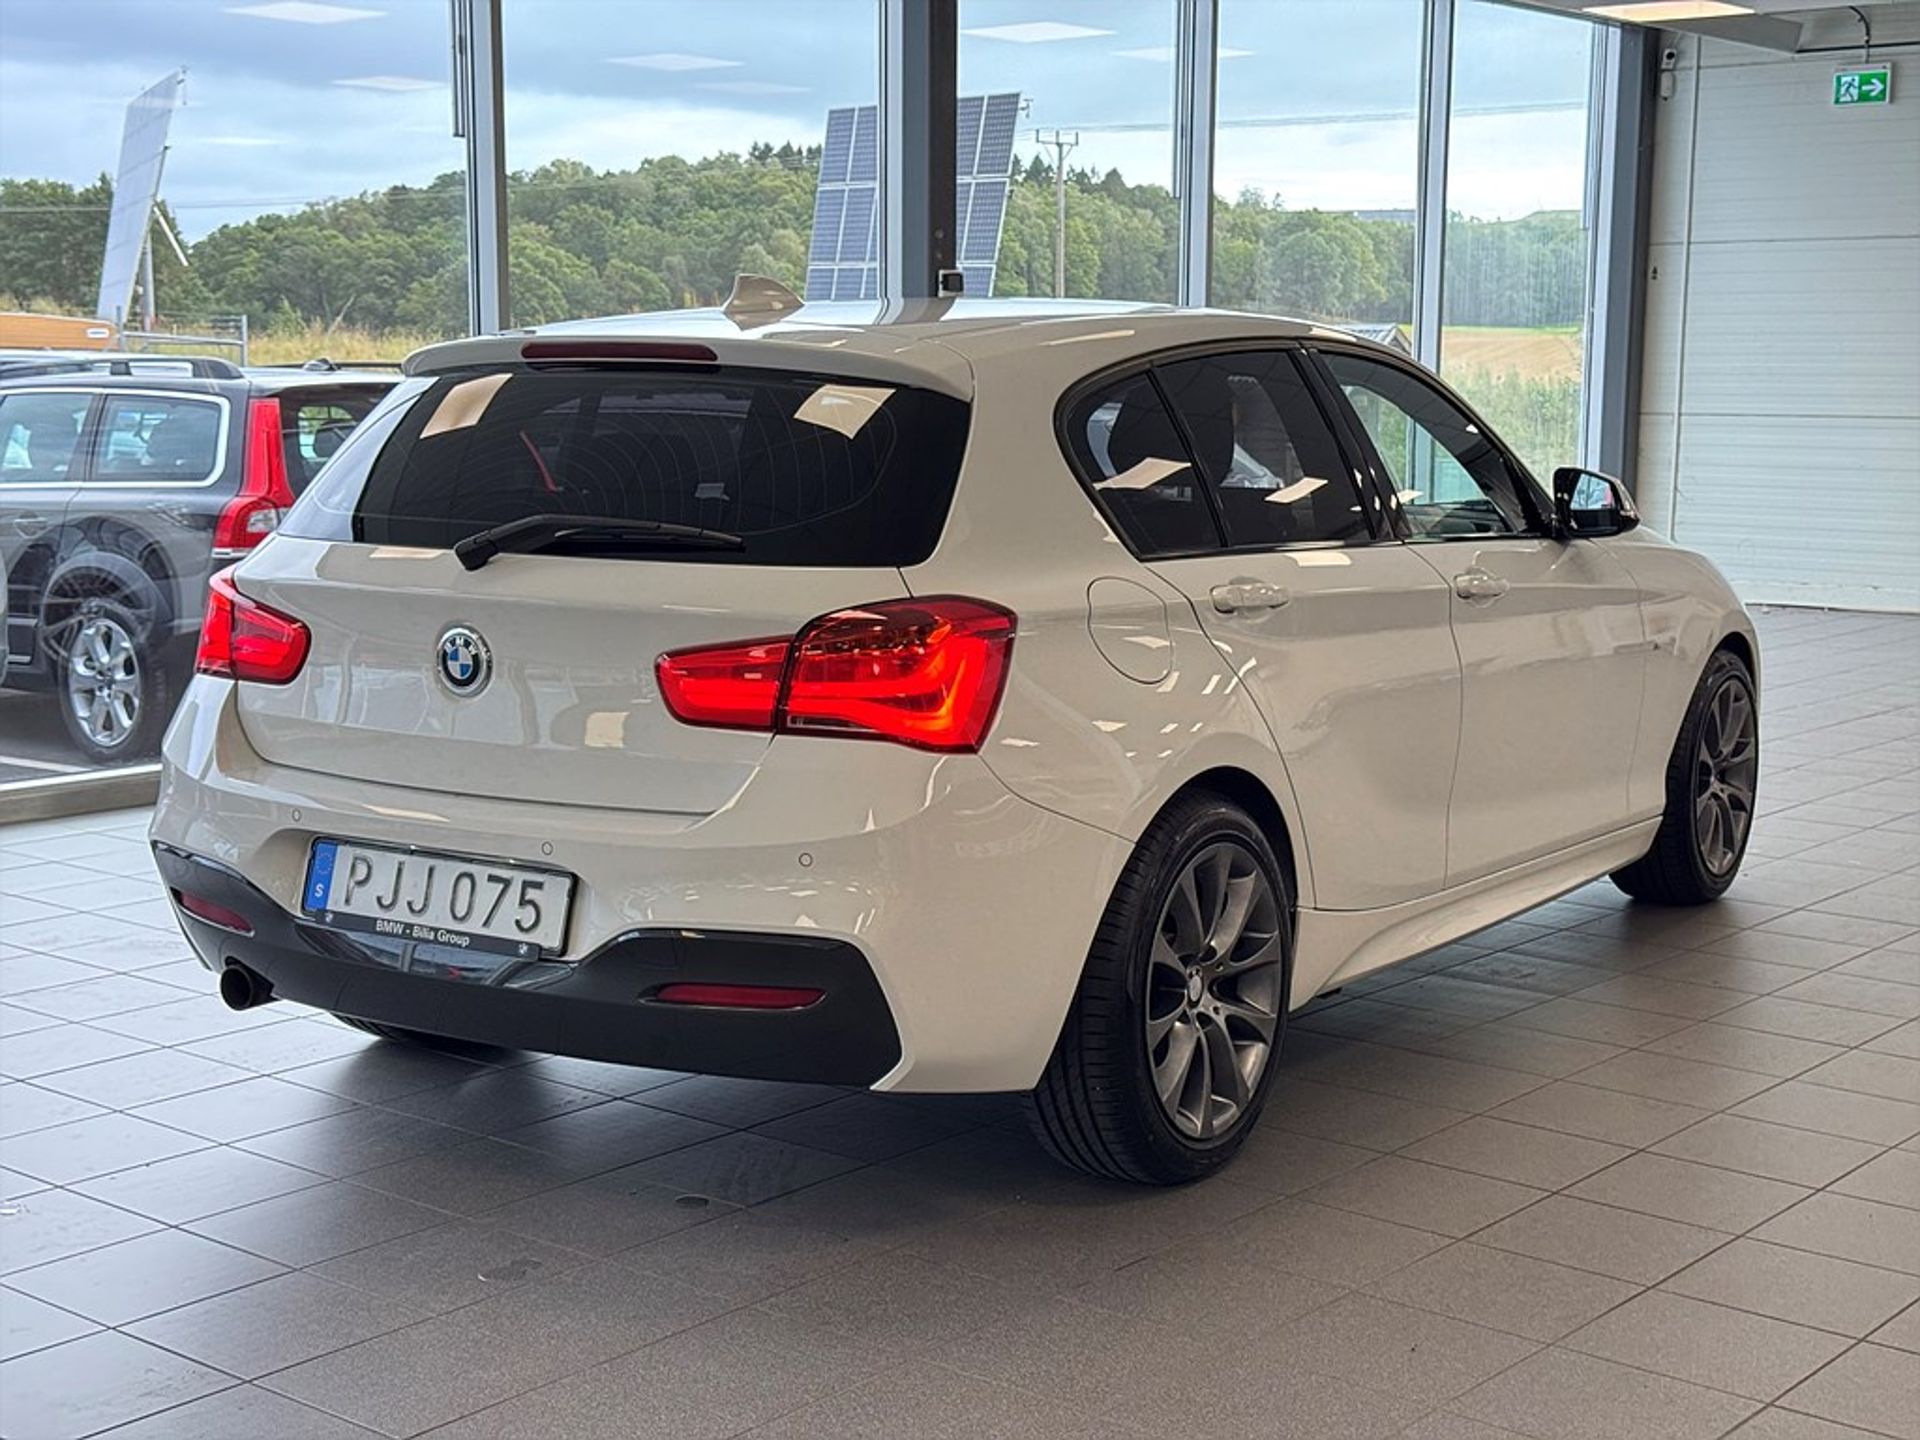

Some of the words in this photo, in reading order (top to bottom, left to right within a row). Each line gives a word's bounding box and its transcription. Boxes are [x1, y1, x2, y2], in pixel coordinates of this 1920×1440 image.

[313, 883, 325, 898] S
[344, 855, 435, 915] PJJ
[449, 870, 545, 933] 075
[375, 920, 405, 935] BMW
[412, 926, 435, 942] Bilia
[437, 929, 470, 947] Group
